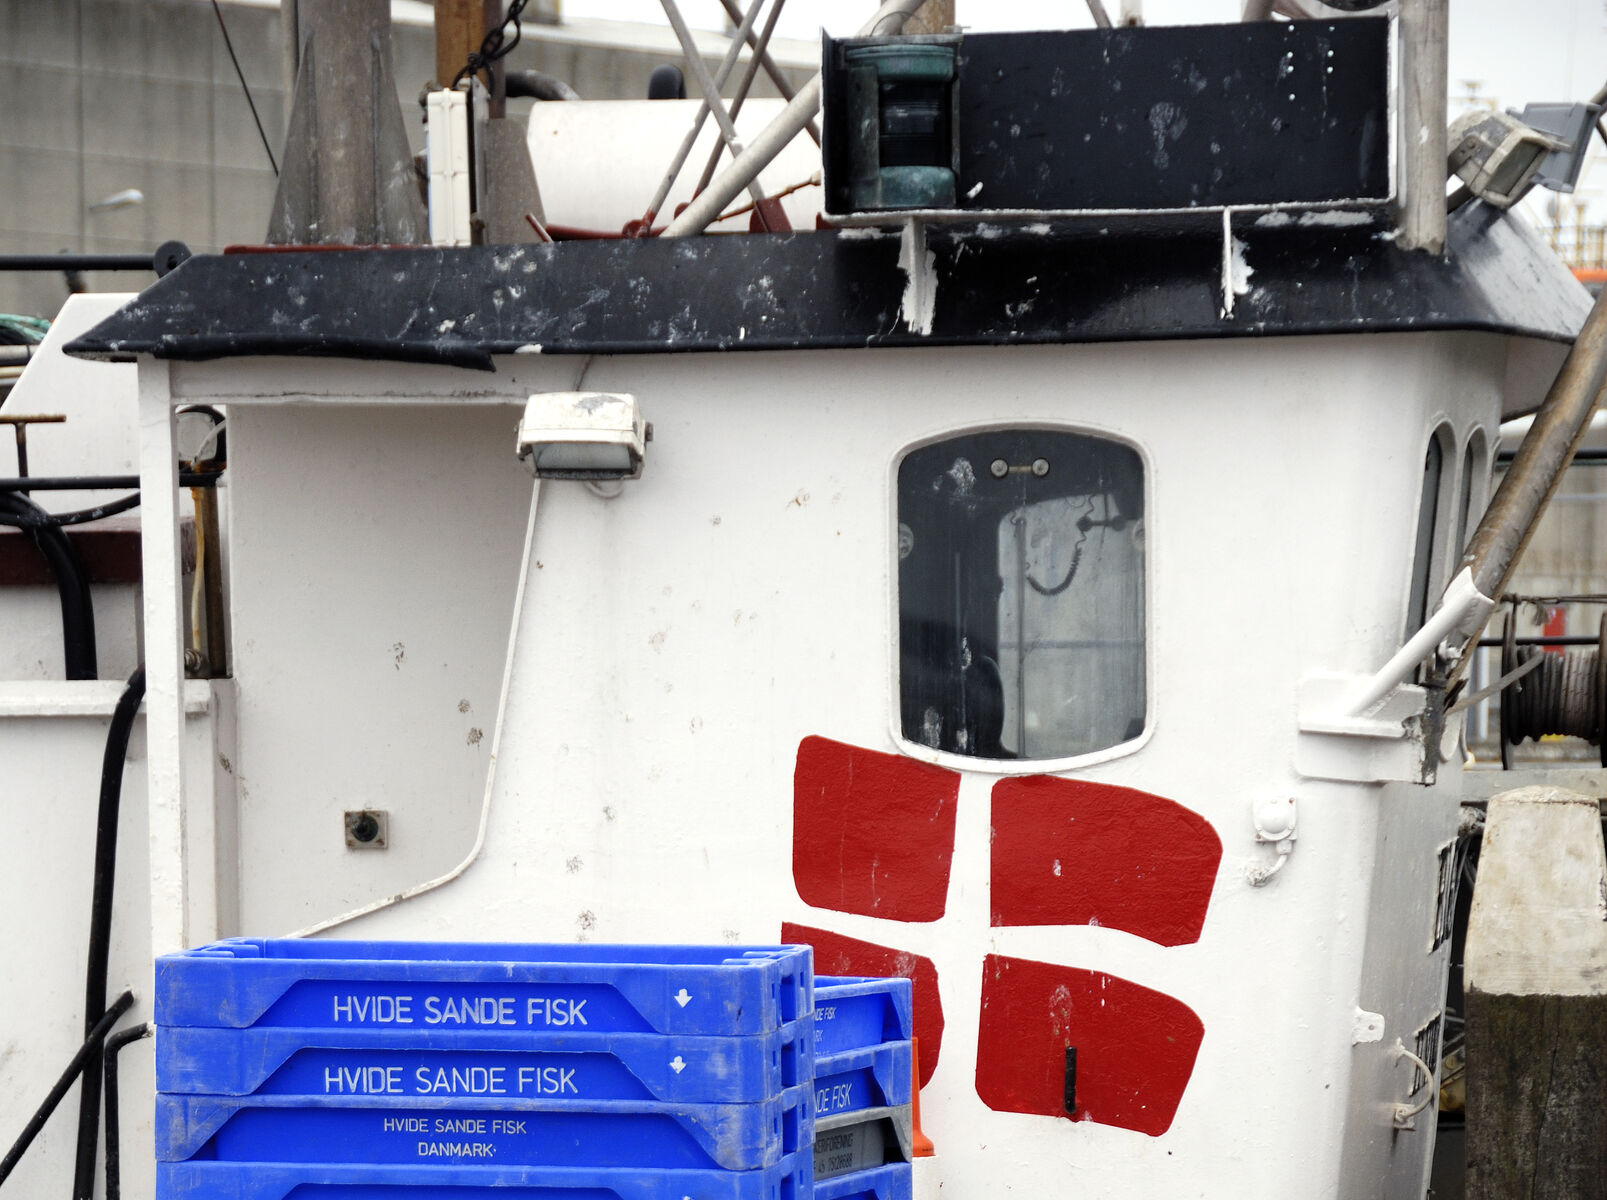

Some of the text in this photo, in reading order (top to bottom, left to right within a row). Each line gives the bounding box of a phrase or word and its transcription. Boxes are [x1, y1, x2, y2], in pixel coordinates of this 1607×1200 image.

[334, 996, 588, 1025] HVIDE SANDE FISK
[325, 1067, 578, 1093] HVIDE SANDE FISK
[831, 1083, 852, 1109] FISK
[384, 1118, 527, 1134] HVIDE SANDE FISK
[418, 1142, 493, 1157] DANMARK
